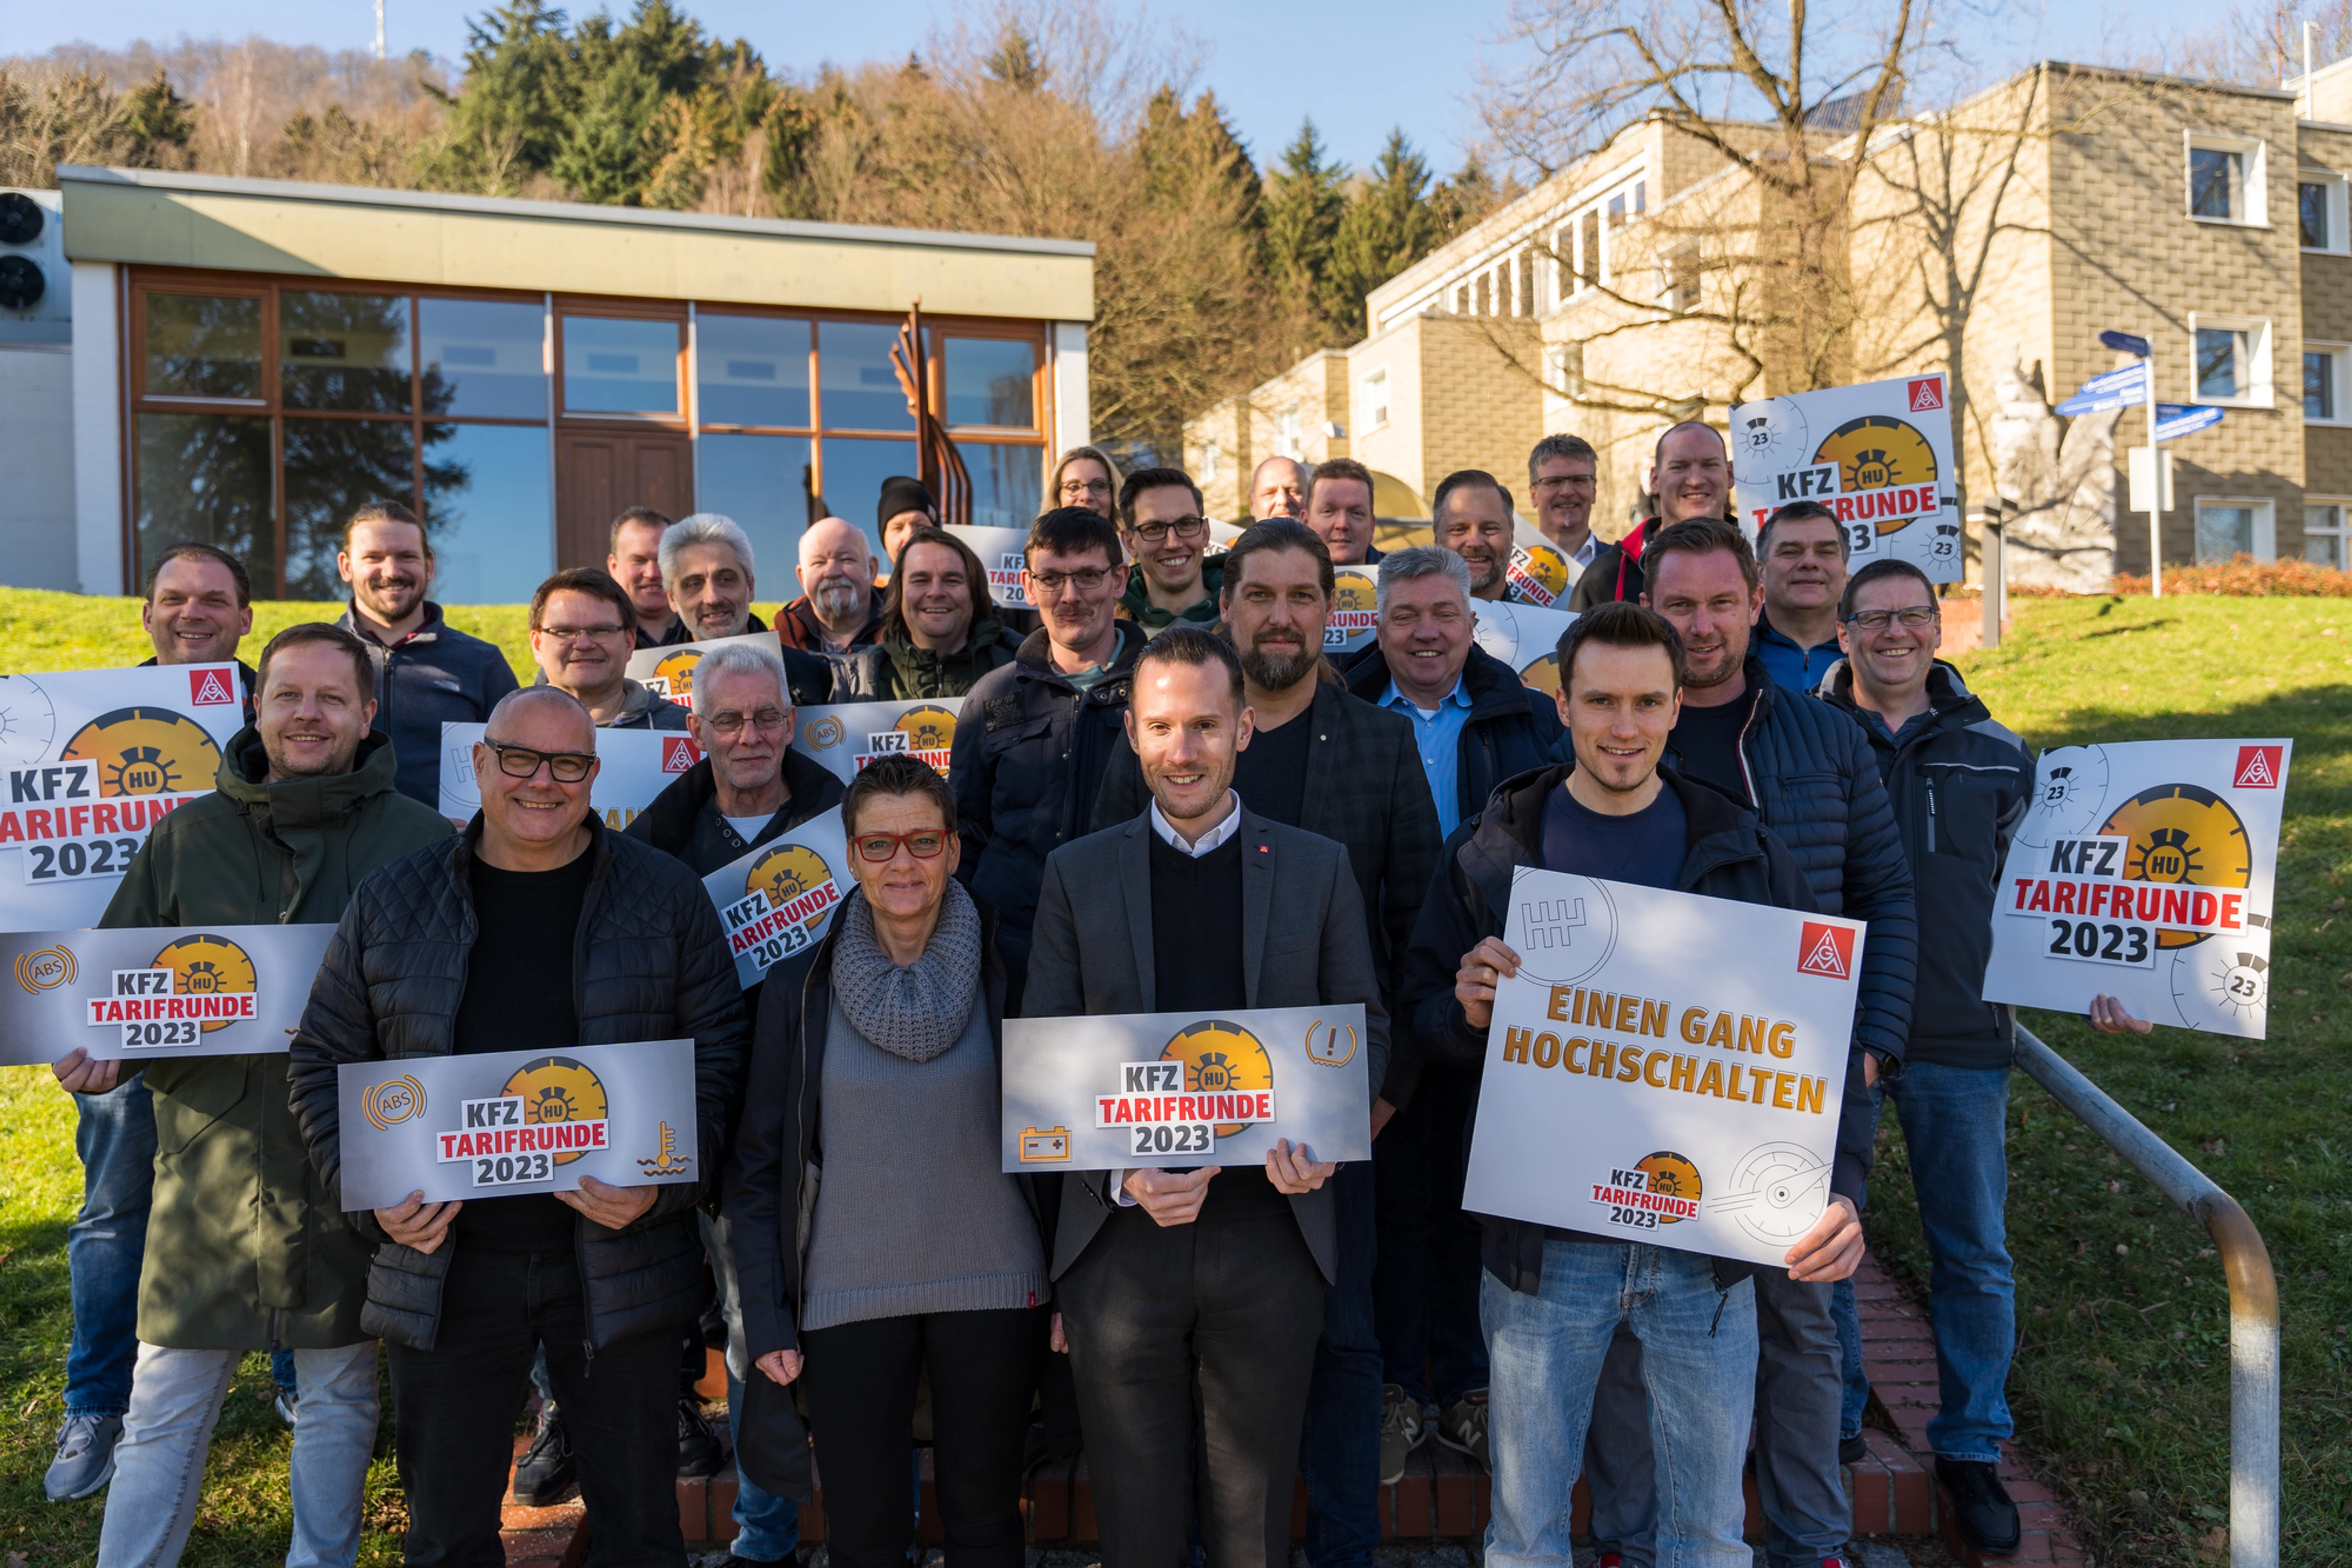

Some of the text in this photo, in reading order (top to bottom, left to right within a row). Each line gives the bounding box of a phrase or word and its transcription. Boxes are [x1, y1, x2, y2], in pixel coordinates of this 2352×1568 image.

[1752, 433, 1768, 446] 23
[1777, 467, 1834, 500] KFZ
[1862, 469, 1883, 484] HU
[1752, 486, 1936, 531] TRUNDE
[1512, 546, 1528, 566] FZ
[1934, 542, 1952, 555] 23
[1004, 556, 1024, 569] KF
[641, 680, 667, 694] FZ
[816, 727, 836, 740] ABS
[872, 734, 905, 752] KFZ
[922, 738, 934, 746] HU
[11, 766, 90, 803] KFZ
[129, 771, 157, 788] HU
[2047, 786, 2064, 800] 23
[30, 838, 139, 879] 2023
[2049, 840, 2119, 875] KFZ
[2151, 856, 2178, 874] HU
[781, 883, 797, 897] HU
[726, 894, 768, 928] KFZ
[2015, 878, 2242, 929] TARIFRUNDE
[726, 882, 840, 954] ARIFRUNDE
[752, 926, 807, 968] 2023
[2050, 920, 2148, 962] 2023
[32, 959, 63, 979] ABS
[117, 972, 168, 995] KFZ
[193, 978, 211, 989] HU
[2230, 976, 2256, 997] 23
[91, 996, 253, 1022] TARIFRUNDE
[1547, 983, 1797, 1060] EINEN GANG
[126, 1022, 196, 1045] 2023
[1126, 1065, 1178, 1092] KFZ
[1204, 1073, 1224, 1086] HU
[1503, 1024, 1828, 1115] HOCHSCHALTEN
[380, 1092, 411, 1113] ABS
[544, 1105, 562, 1117] HU
[1099, 1094, 1270, 1123] TARIFRUNDE
[467, 1101, 518, 1128] KFZ
[441, 1123, 606, 1158] TARIFRUNDE
[1135, 1125, 1209, 1153] 2023
[477, 1154, 549, 1183] 2023
[1611, 1169, 1645, 1189] KFZ
[1659, 1183, 1672, 1191] HU
[1593, 1185, 1697, 1217] TARIFRUNDE
[1610, 1206, 1656, 1228] 2023
